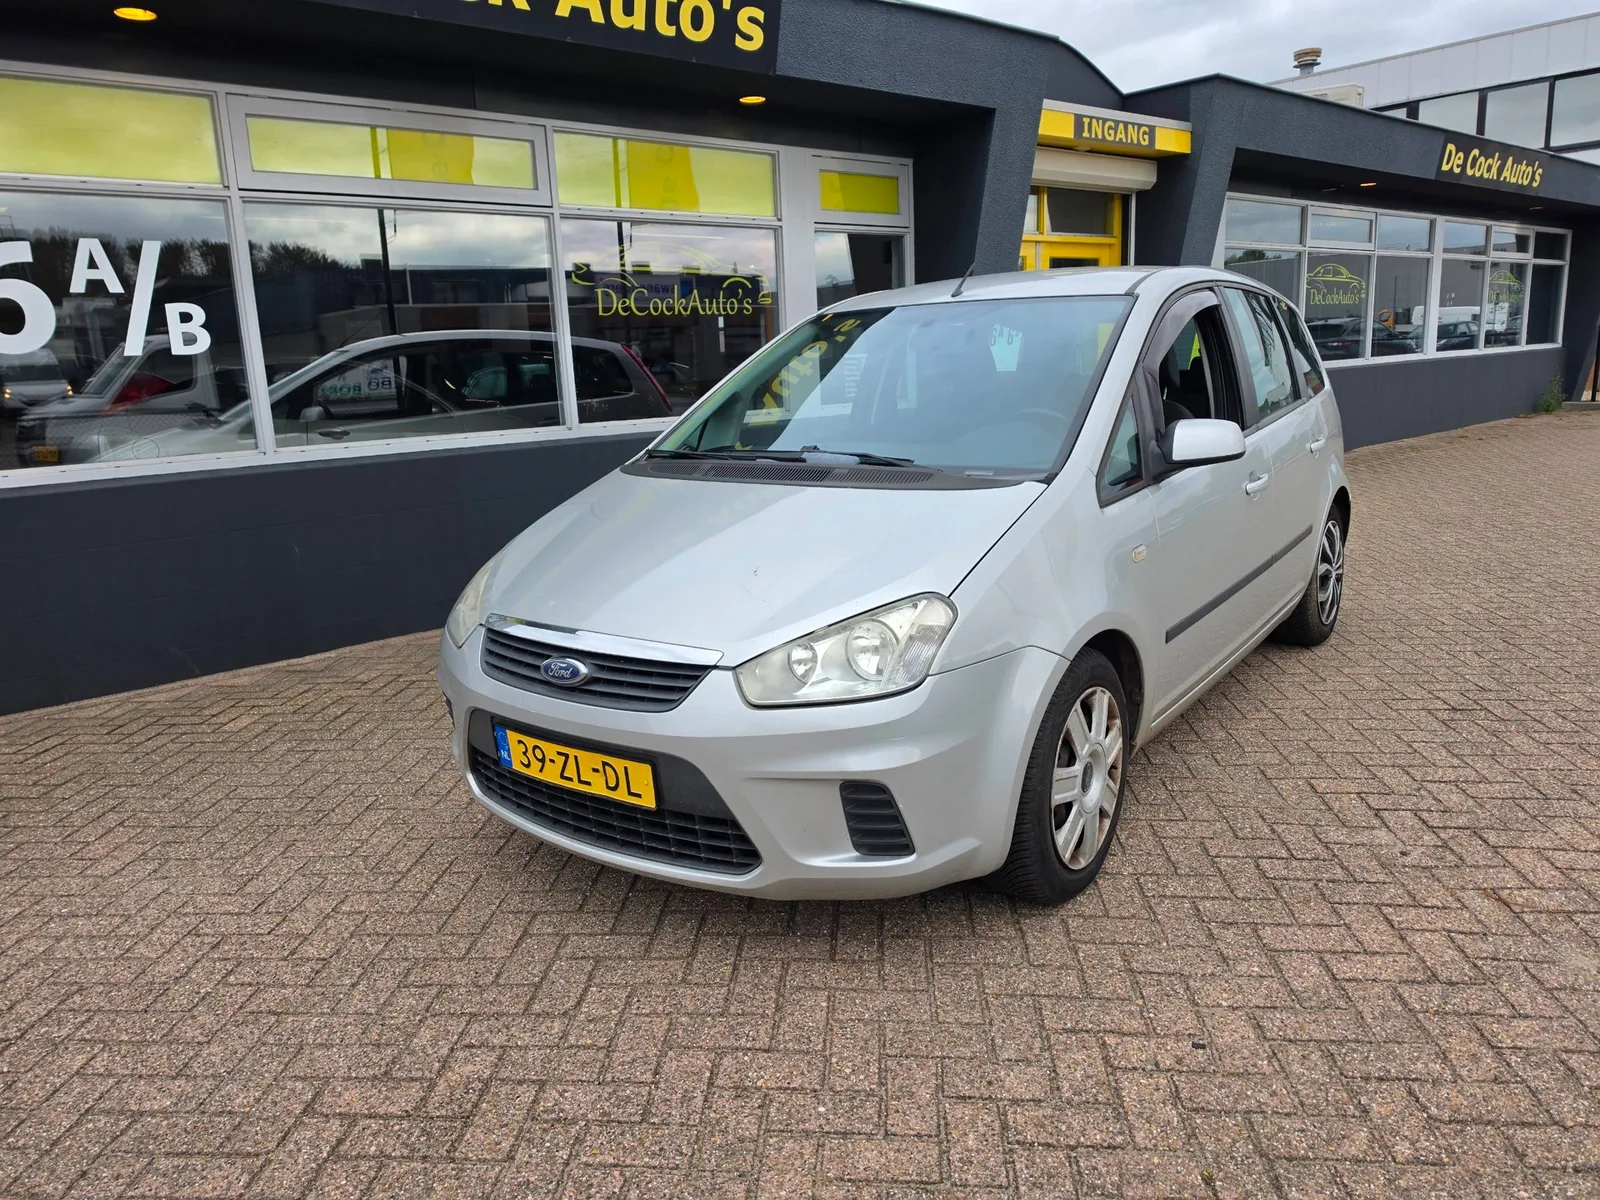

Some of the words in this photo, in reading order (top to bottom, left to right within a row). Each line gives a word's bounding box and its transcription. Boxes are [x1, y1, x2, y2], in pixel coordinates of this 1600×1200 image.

[1082, 117, 1150, 146] INGANG
[1441, 142, 1464, 174] De
[1466, 148, 1501, 180] Cock
[1500, 156, 1543, 188] Auto's
[594, 284, 753, 316] DeCockAuto's
[547, 661, 573, 679] Ford
[500, 749, 511, 761] NL
[516, 739, 643, 799] 39-ZL-DL
